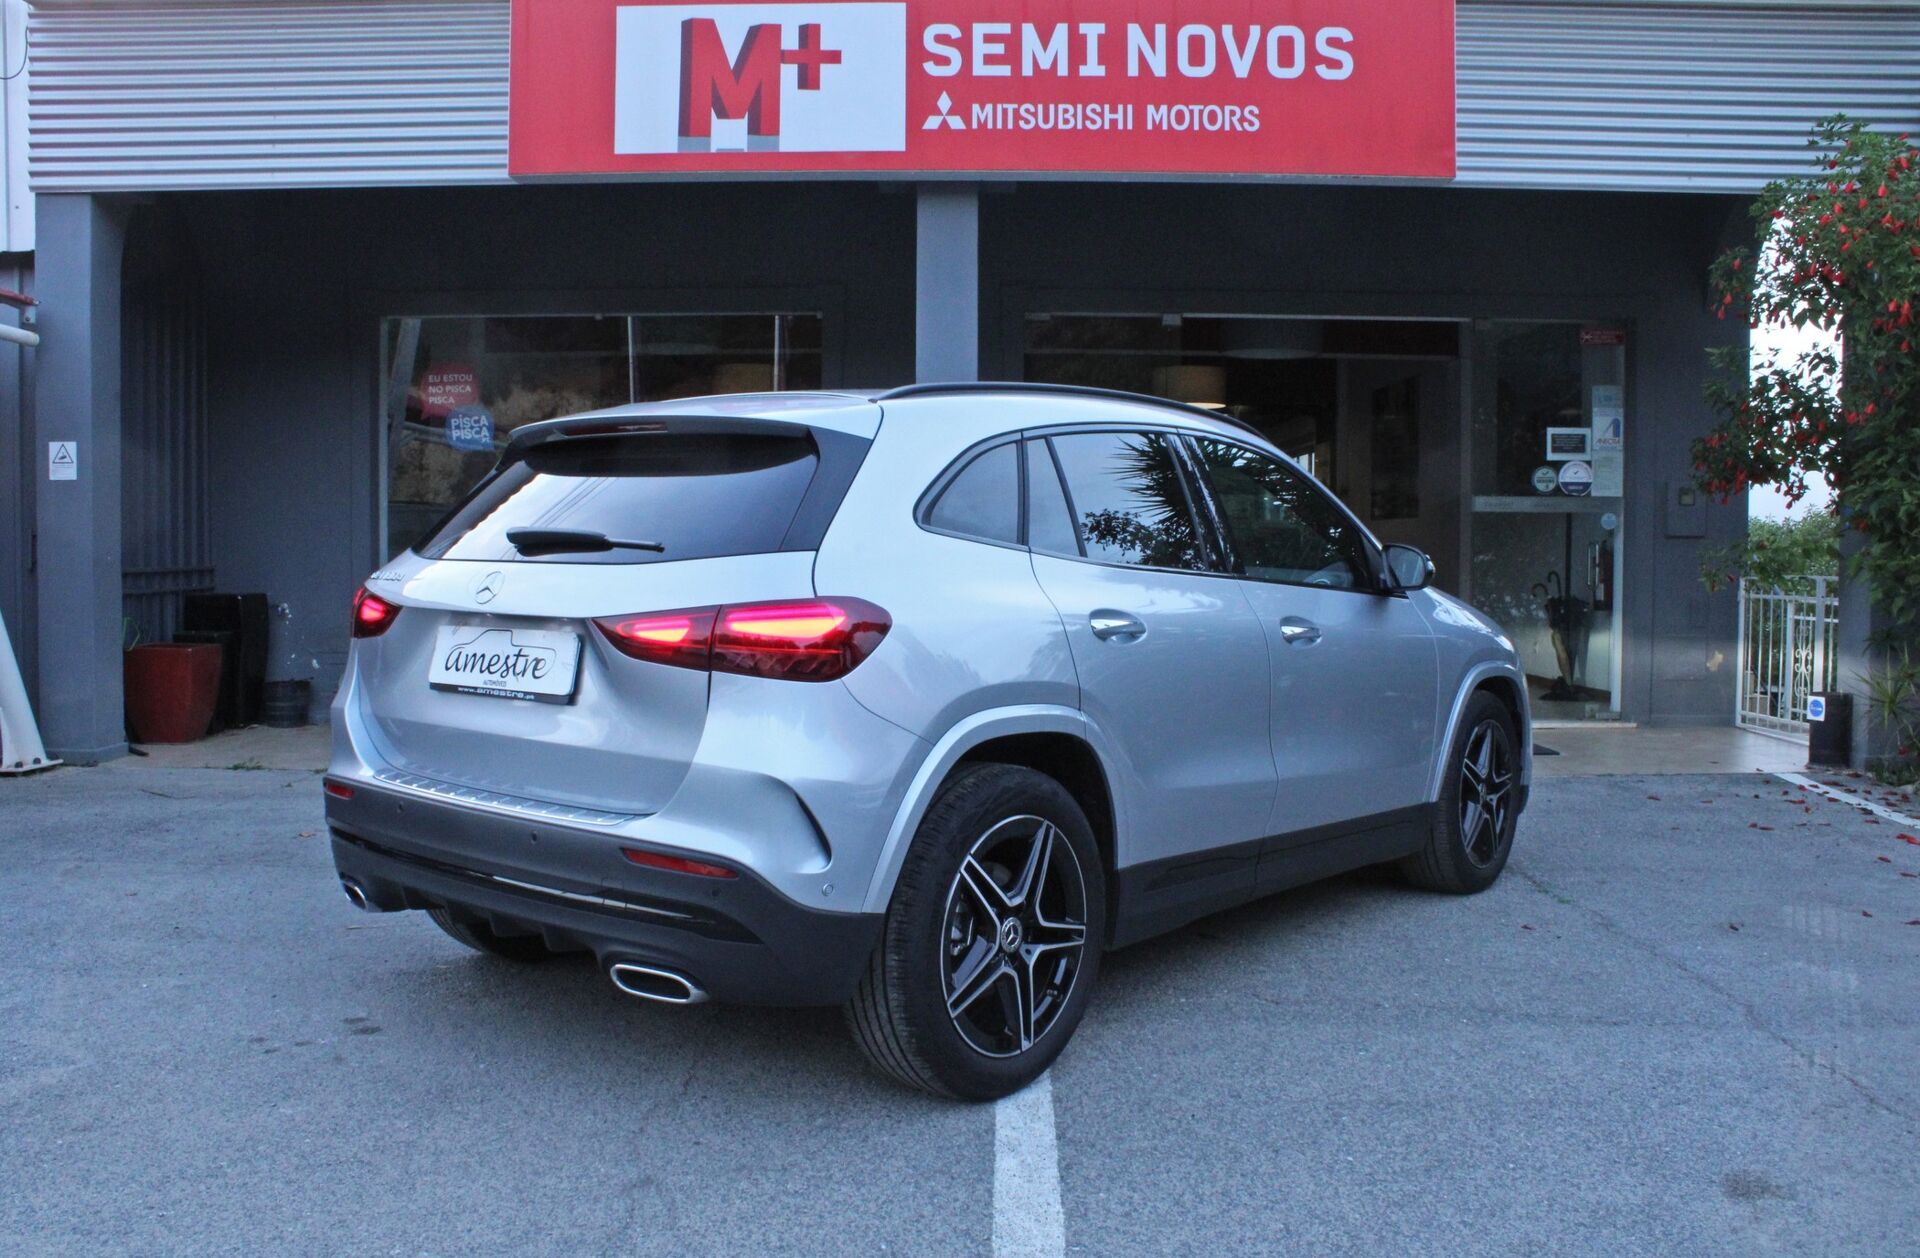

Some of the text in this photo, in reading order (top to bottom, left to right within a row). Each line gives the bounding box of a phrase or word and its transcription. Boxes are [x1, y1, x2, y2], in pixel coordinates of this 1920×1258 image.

[922, 22, 1354, 81] SEMI NOVOS
[971, 103, 1261, 132] MITSUBISHI MOTORS
[428, 374, 473, 382] EU ESTOU
[428, 385, 472, 394] NO PISCA
[428, 396, 455, 404] PISCA
[445, 646, 548, 679] amestre
[457, 686, 536, 701] www.amestre.pt
